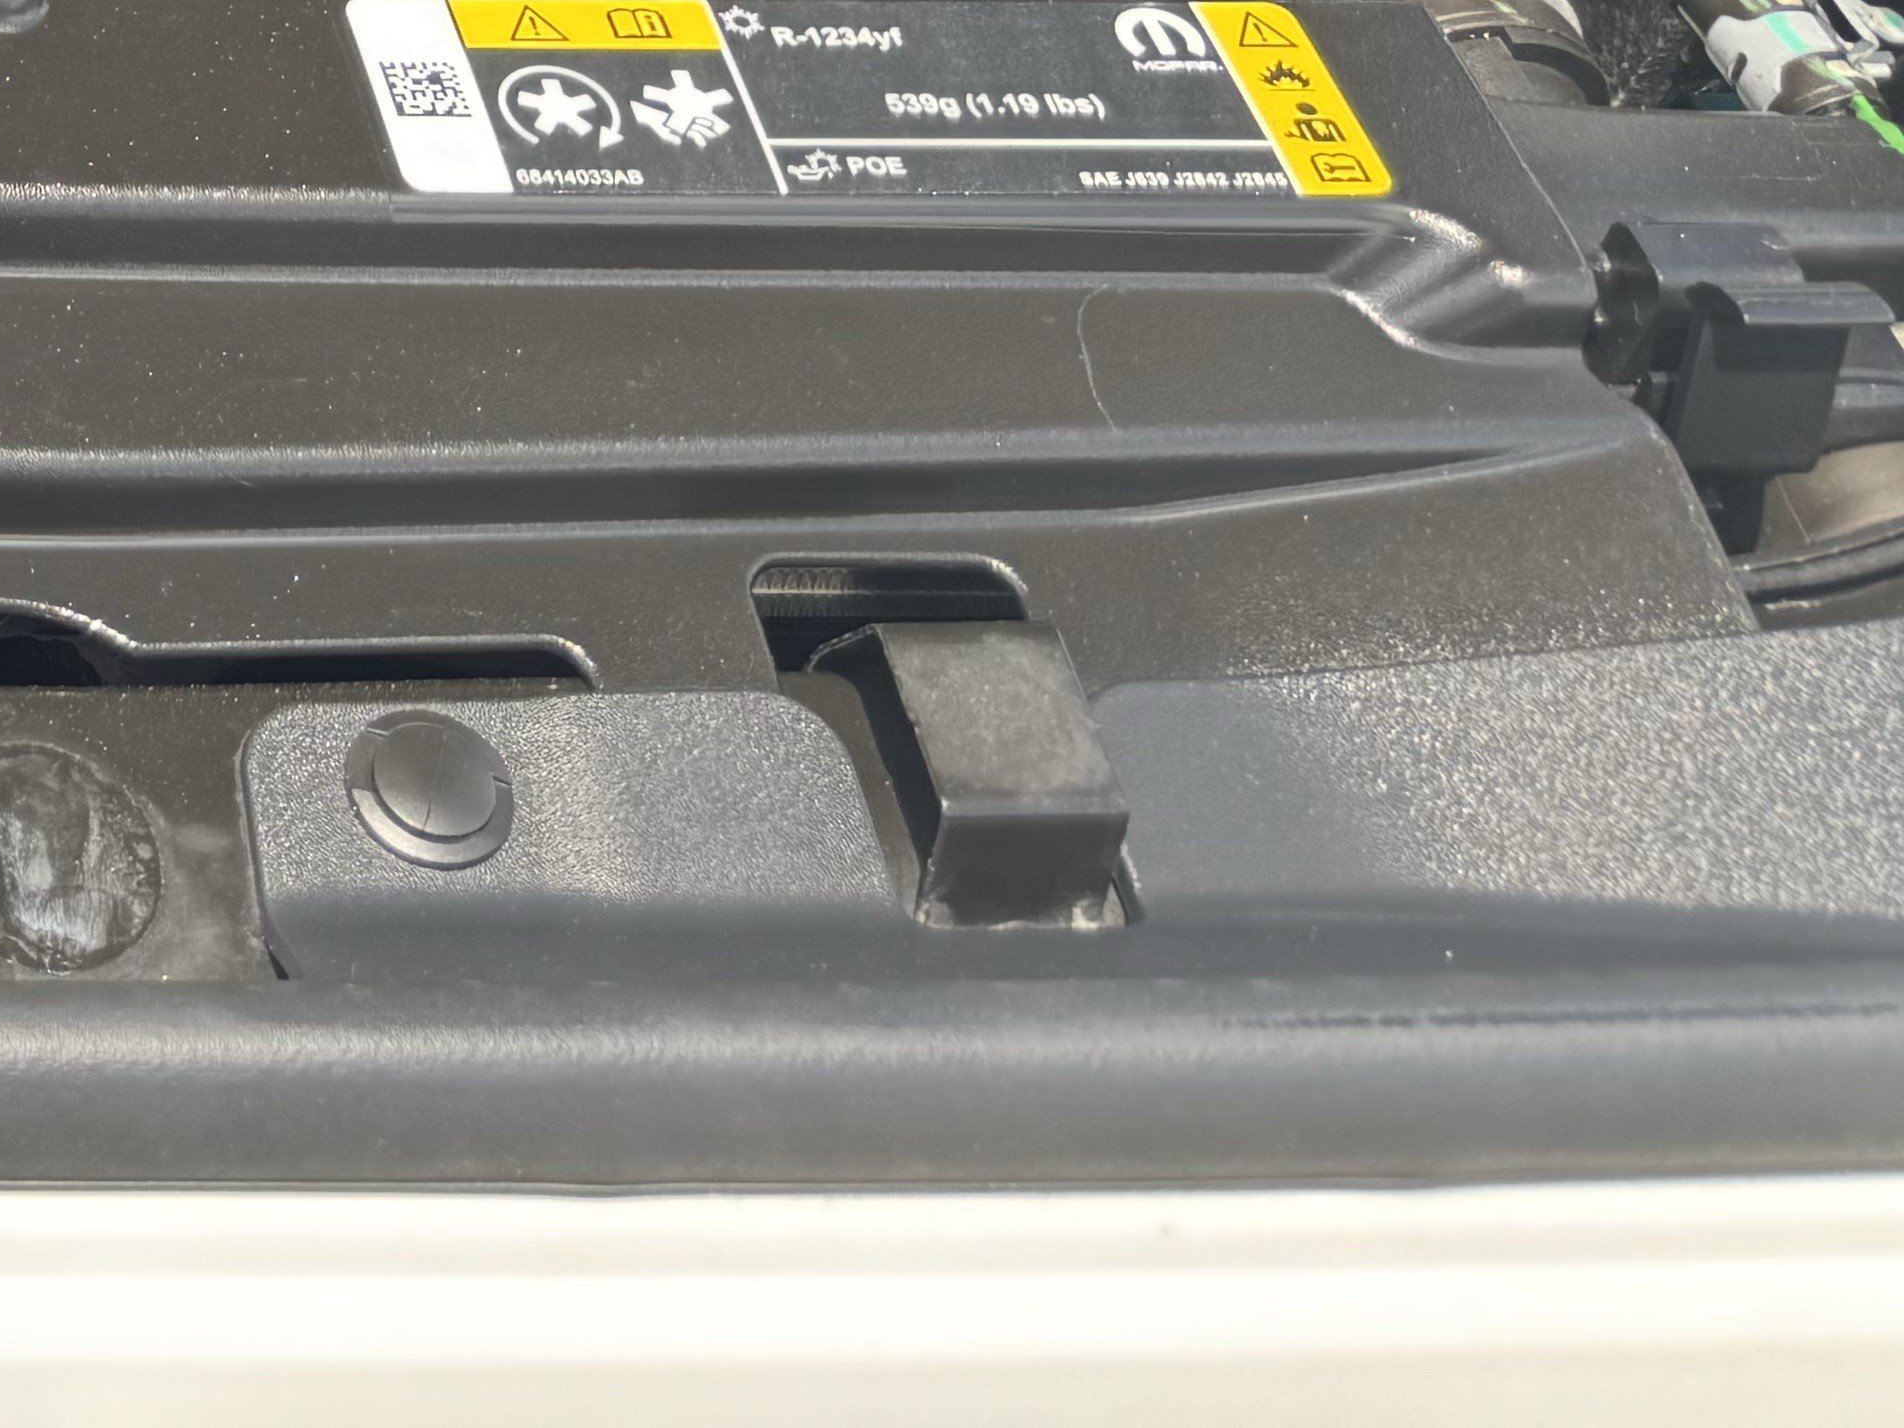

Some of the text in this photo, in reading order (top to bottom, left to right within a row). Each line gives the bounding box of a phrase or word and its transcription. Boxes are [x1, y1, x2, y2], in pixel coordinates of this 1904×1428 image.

[885, 93, 1106, 121] 539g (1.19 lbs)
[846, 156, 907, 176] POE
